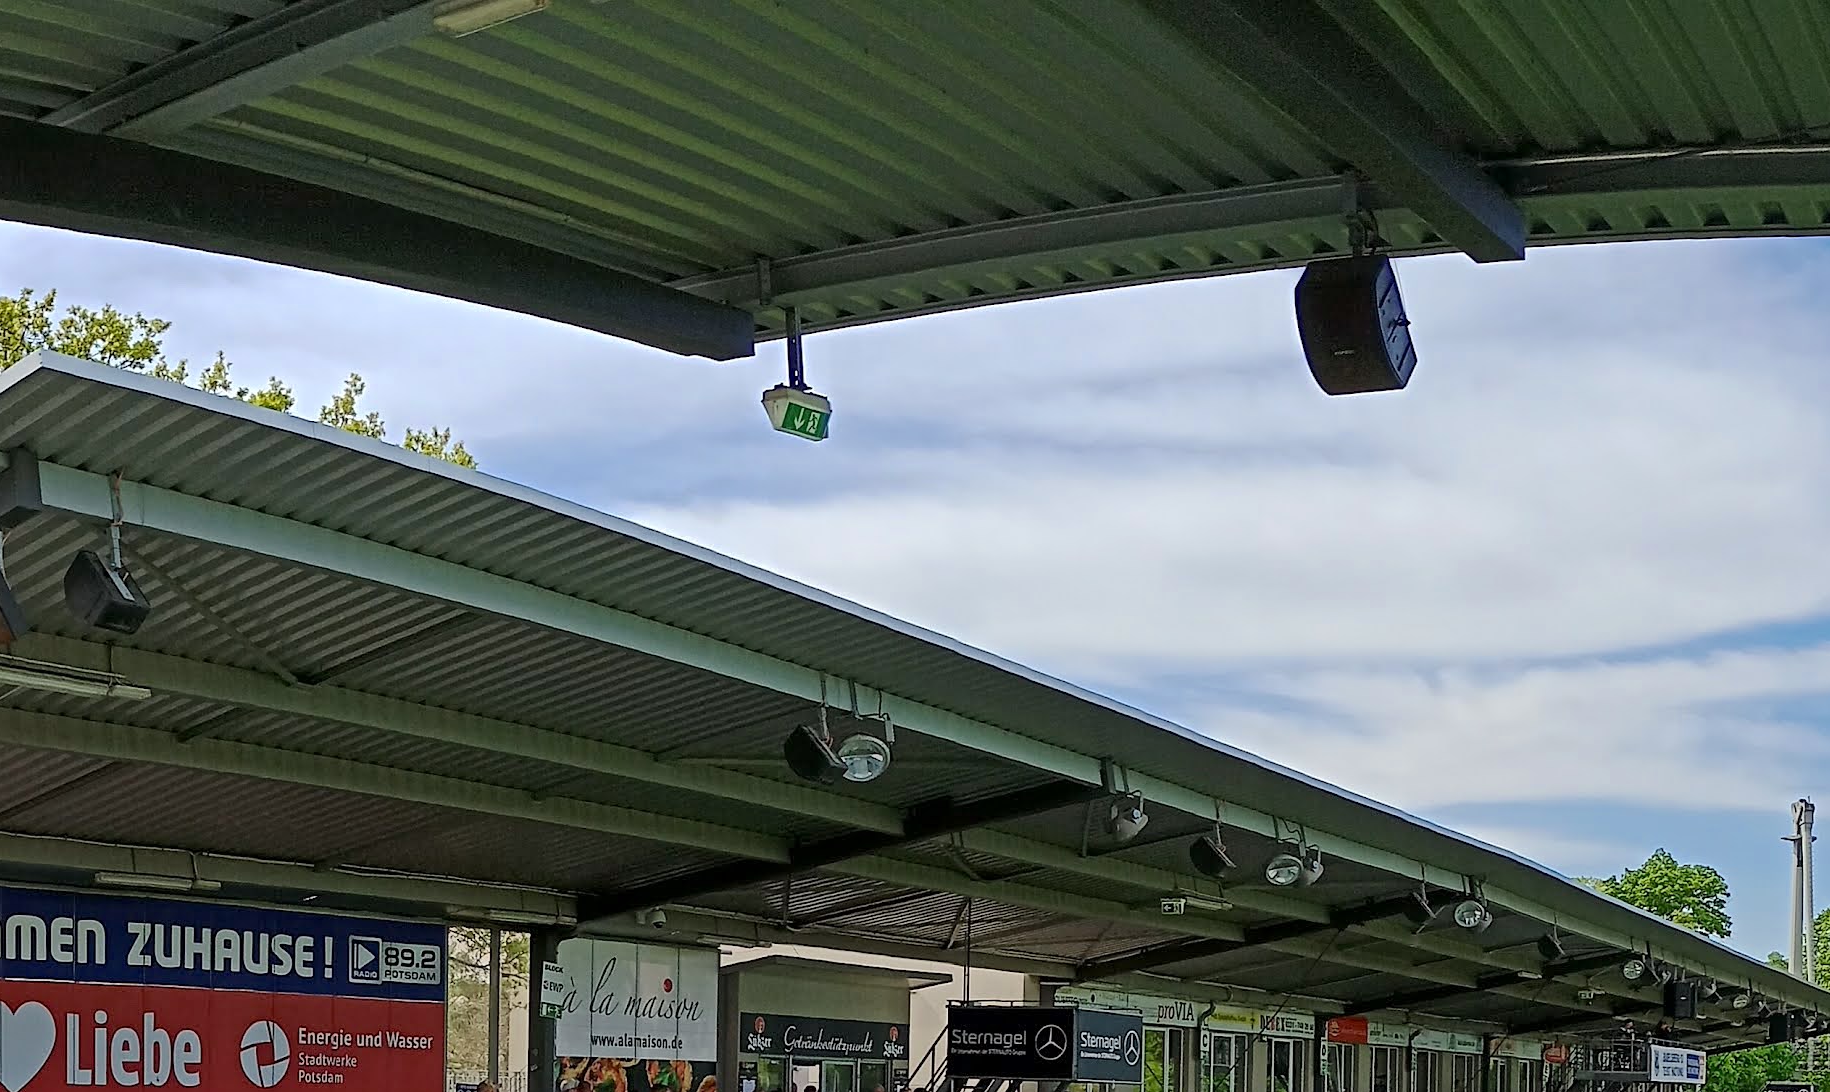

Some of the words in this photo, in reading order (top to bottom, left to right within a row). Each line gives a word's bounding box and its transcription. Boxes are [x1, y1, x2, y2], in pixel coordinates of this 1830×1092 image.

[384, 948, 436, 968] 89.2
[354, 970, 377, 979] RADIO
[384, 970, 436, 981] POTSDAM
[545, 964, 564, 973] BLOCK
[589, 957, 619, 1016] la
[624, 996, 704, 1021] maison
[1157, 1001, 1194, 1022] proVIA
[298, 1027, 352, 1050] Energie
[356, 1031, 382, 1048] und
[387, 1033, 433, 1050] Wasser
[591, 1033, 683, 1050] www.alamaison.de
[951, 1029, 1027, 1048] Sternagel
[1080, 1032, 1121, 1052] Sternagel
[66, 1010, 202, 1087] Liebe
[298, 1053, 357, 1068] Stadtwerke
[298, 1069, 344, 1084] Potsdam
